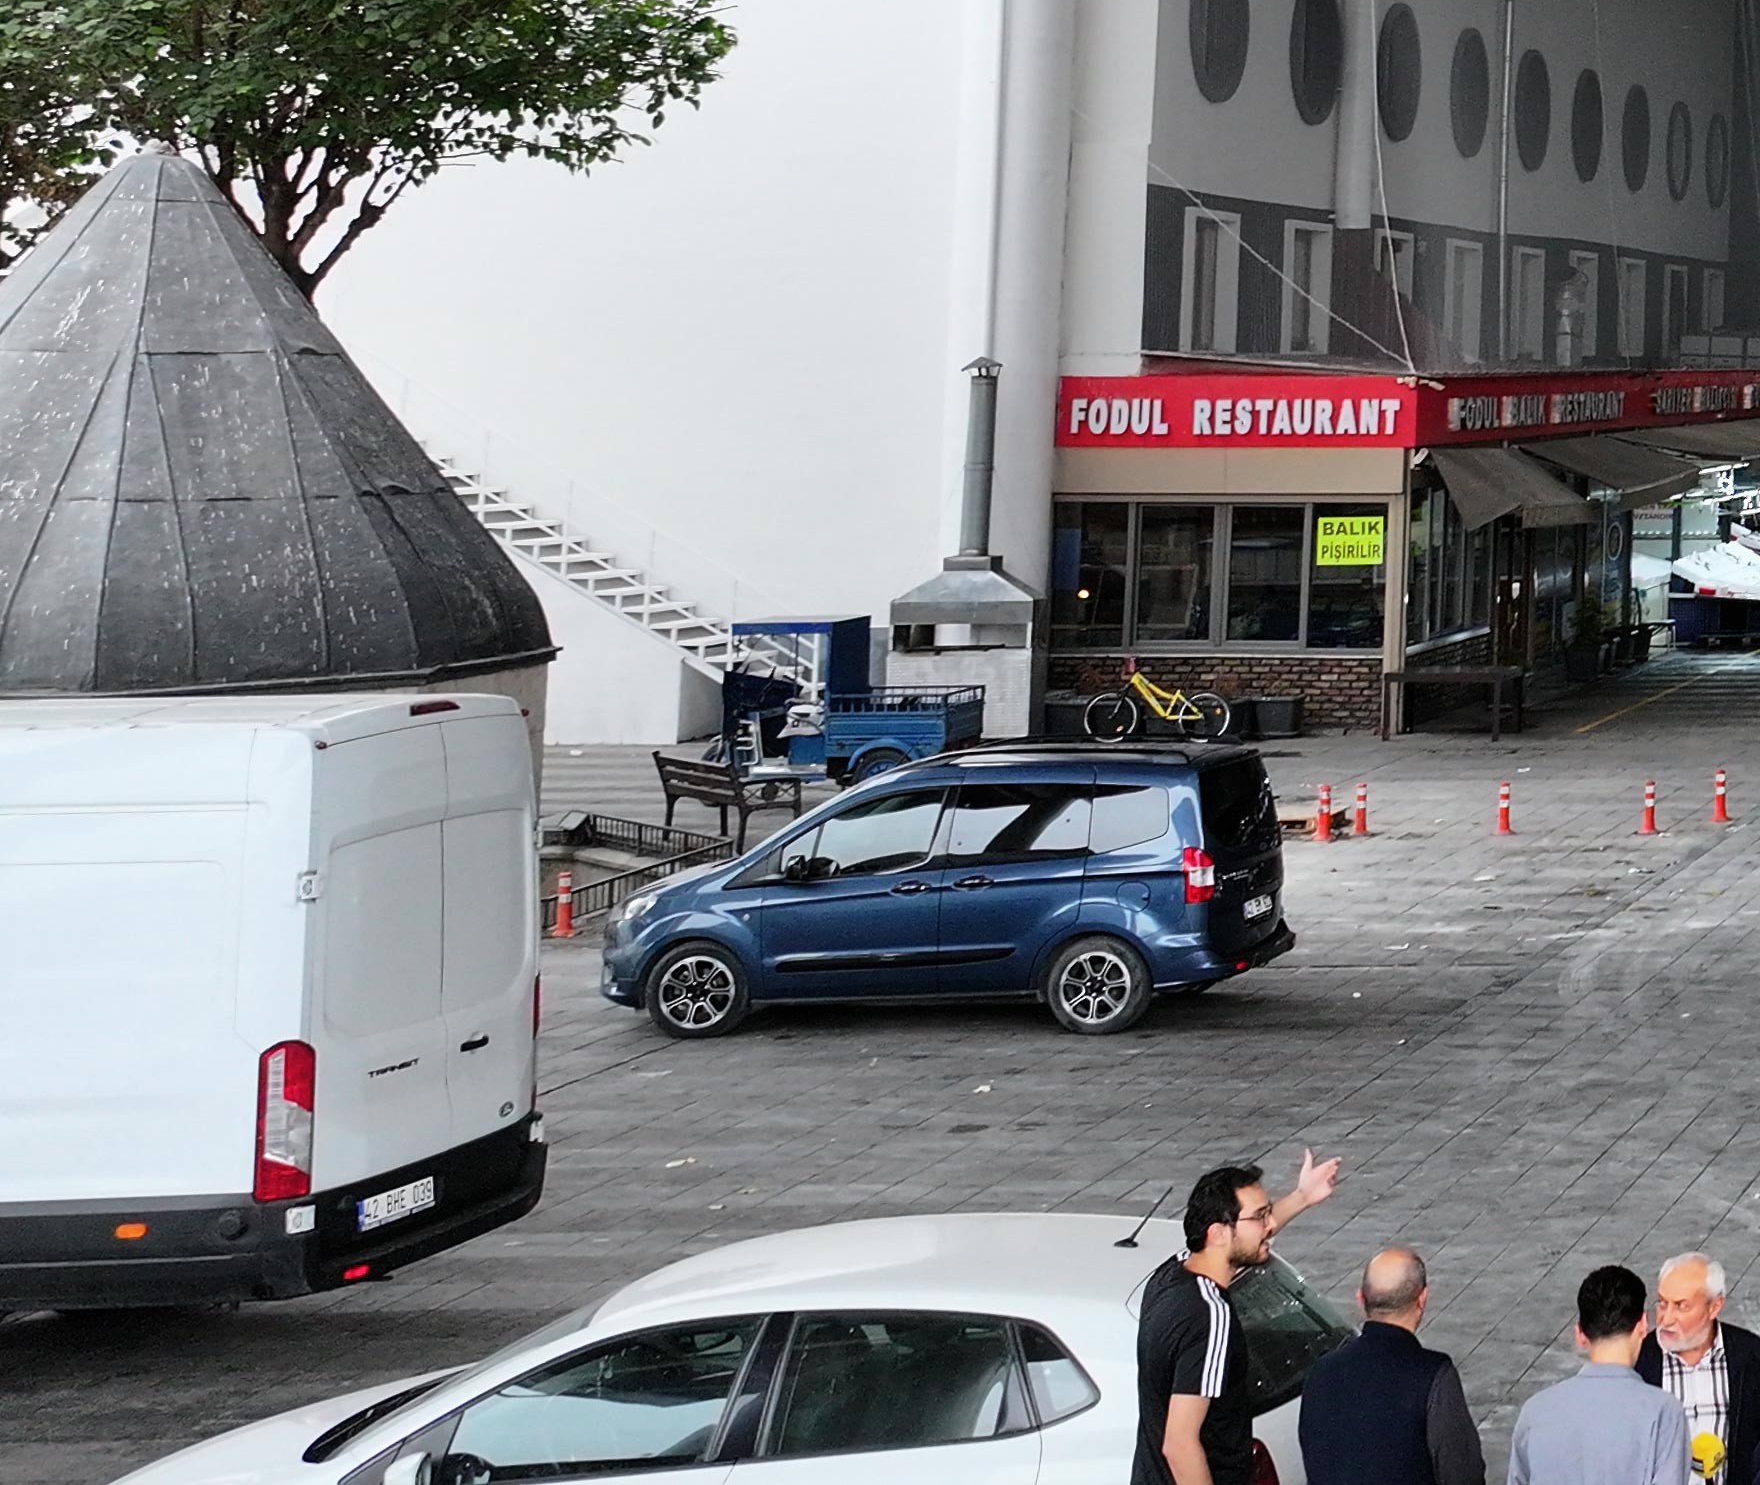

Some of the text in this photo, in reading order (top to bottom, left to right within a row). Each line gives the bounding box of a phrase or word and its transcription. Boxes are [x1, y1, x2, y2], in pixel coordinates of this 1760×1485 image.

[1070, 398, 1400, 435] FODUL RESTAURANT
[1323, 521, 1380, 535] BALIK
[1321, 541, 1380, 562] PİŞİRİLİR
[365, 1180, 432, 1220] 42 BHE 039
